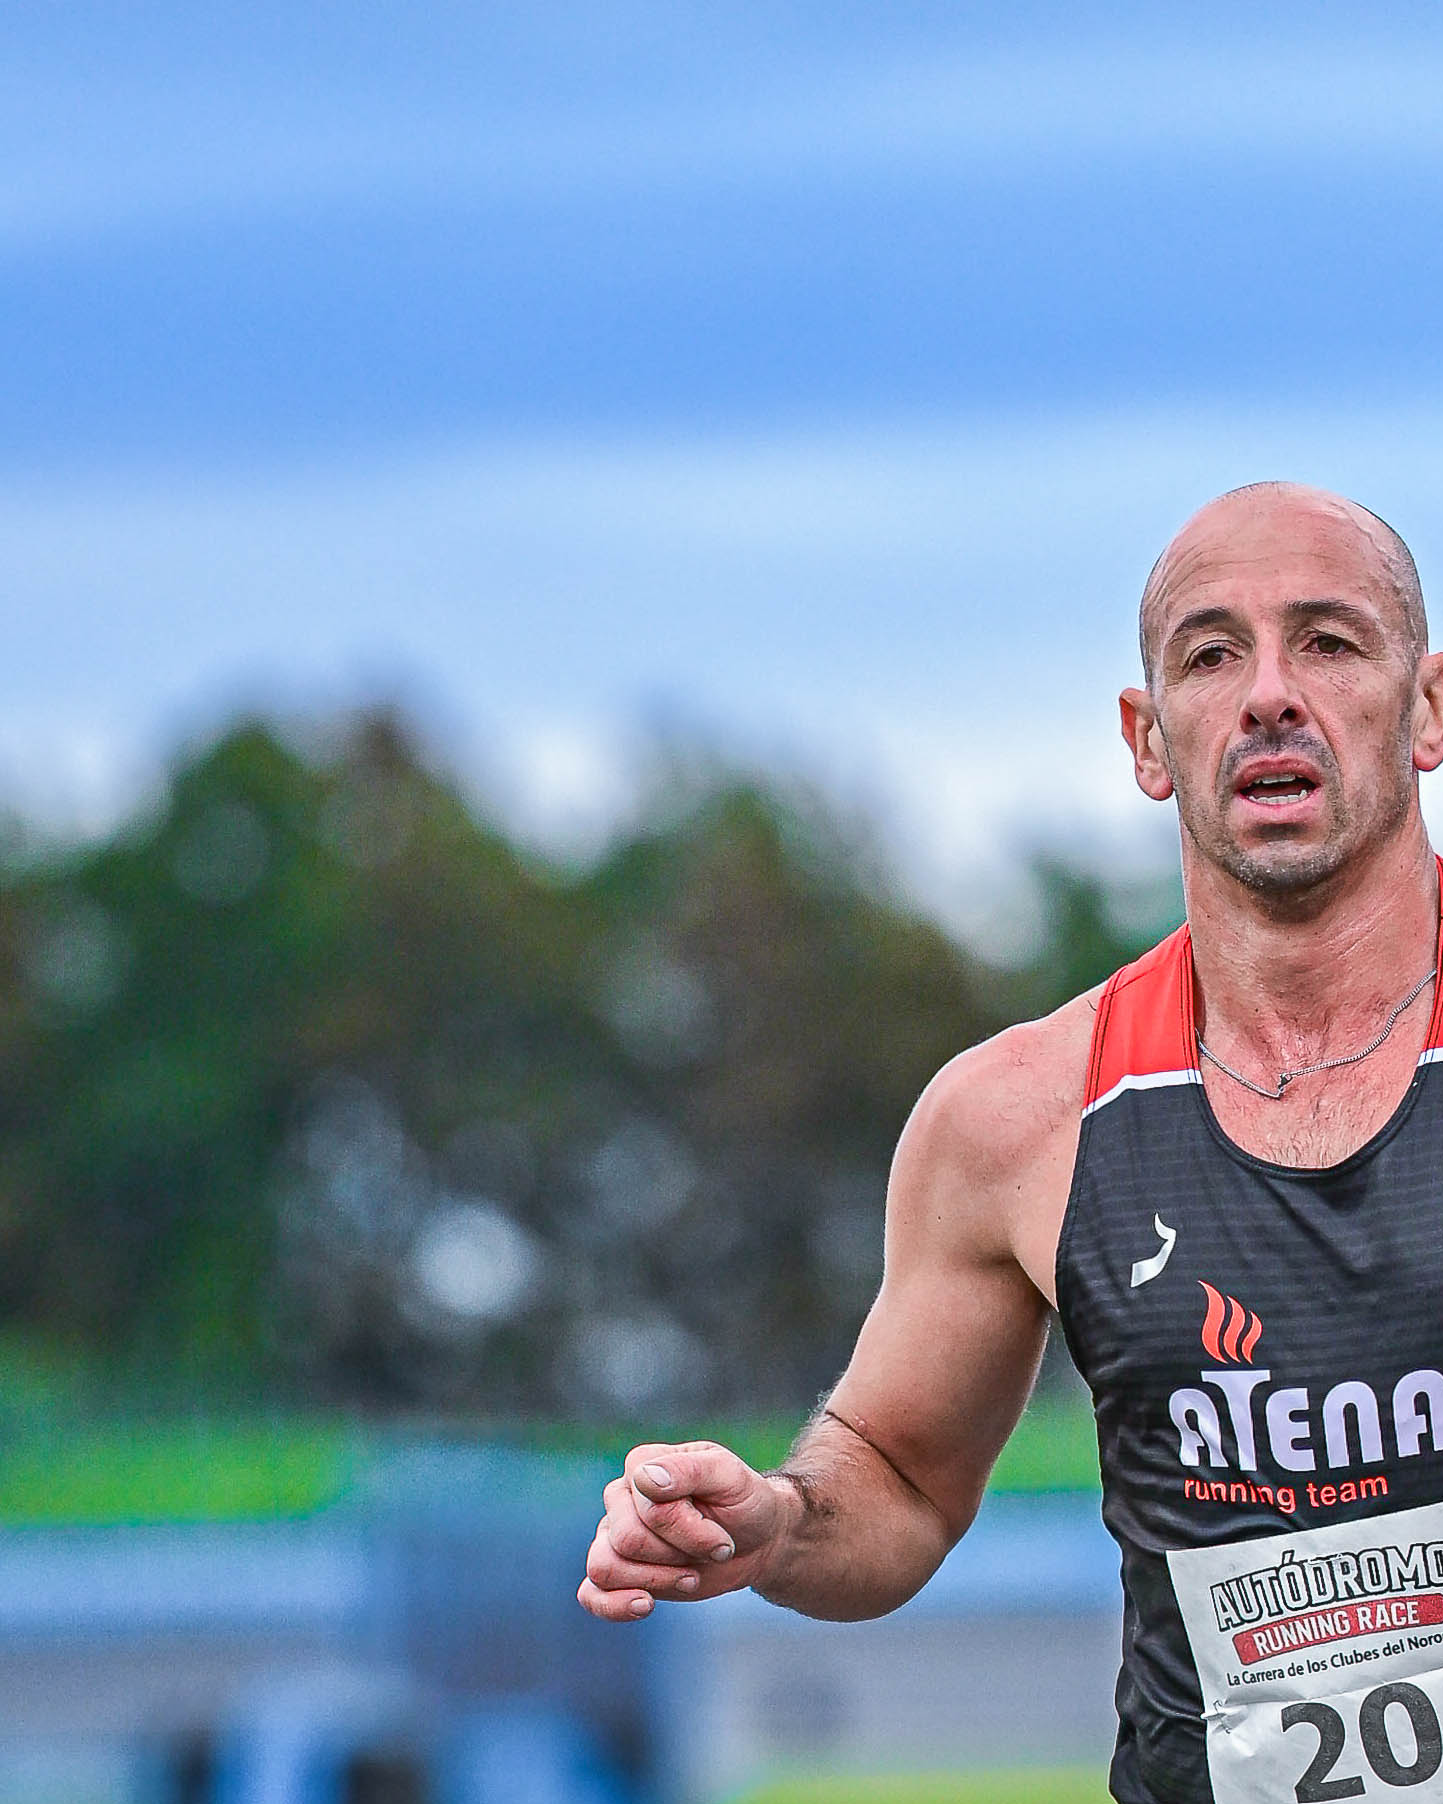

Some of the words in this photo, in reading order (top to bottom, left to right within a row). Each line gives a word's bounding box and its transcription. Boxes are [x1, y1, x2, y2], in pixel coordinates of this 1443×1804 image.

[1184, 1478, 1297, 1514] running
[1306, 1476, 1388, 1508] team
[1252, 1613, 1351, 1657] RUNNING
[1357, 1601, 1419, 1631] RACE
[1227, 1672, 1241, 1687] La
[1242, 1668, 1285, 1685] Carrera
[1287, 1662, 1305, 1678] de
[1306, 1659, 1328, 1674] los
[1330, 1649, 1380, 1669] Clubes
[1381, 1641, 1405, 1657] del
[1281, 1682, 1443, 1804] 20
